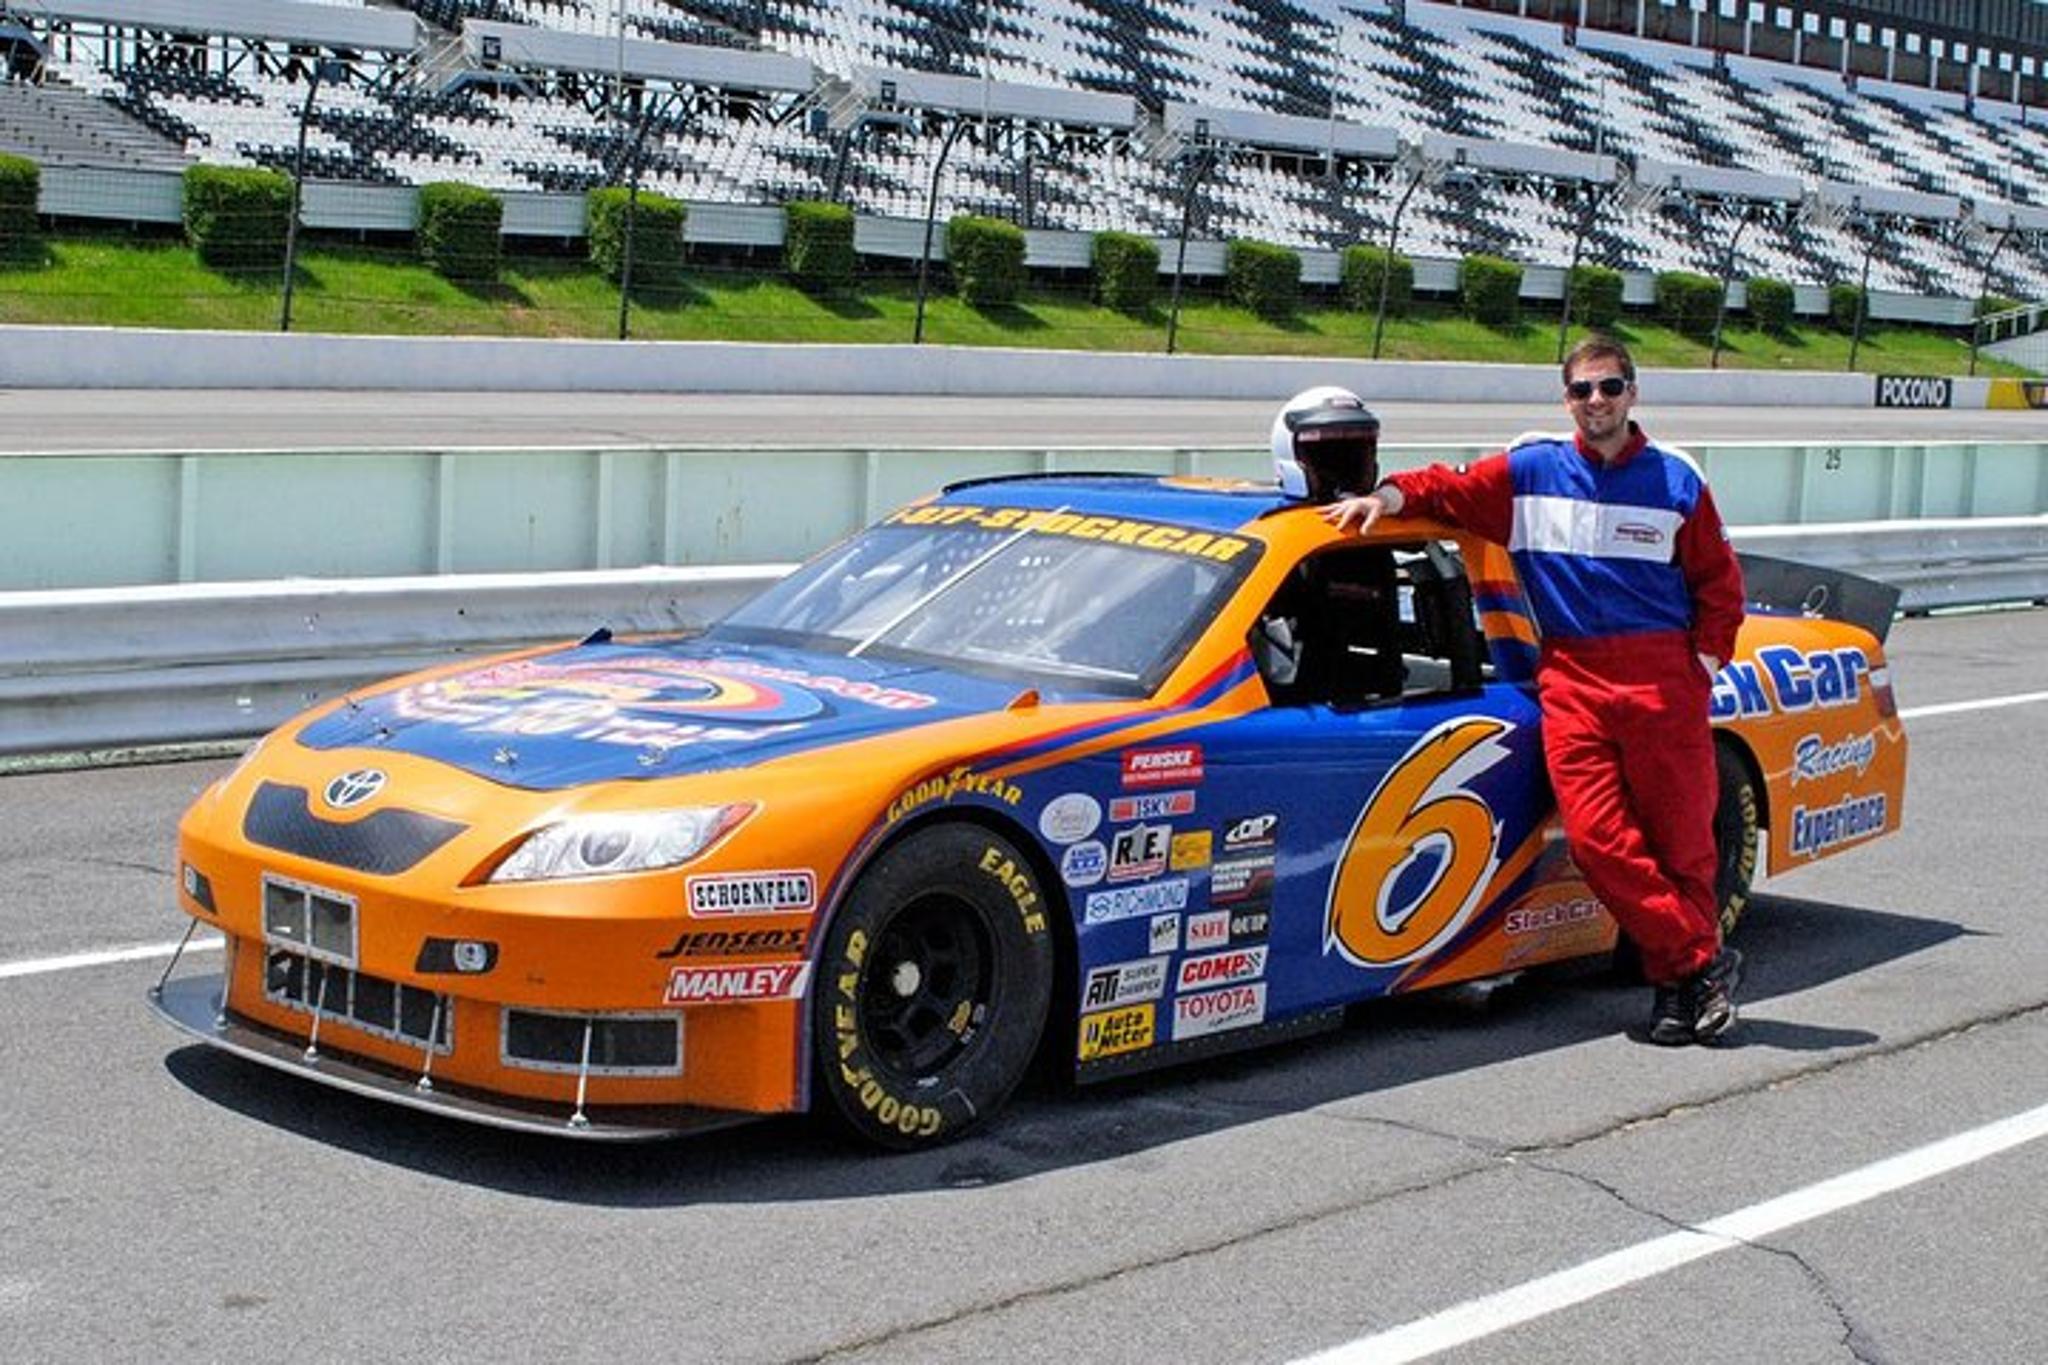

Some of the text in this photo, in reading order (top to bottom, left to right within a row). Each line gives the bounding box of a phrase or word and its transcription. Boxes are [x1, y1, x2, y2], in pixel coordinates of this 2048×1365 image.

[1881, 377, 1947, 406] POCONO
[1755, 645, 1870, 712] Car
[1792, 733, 1875, 788] Racing
[1323, 716, 1516, 968] 6
[1790, 794, 1887, 859] Experience
[696, 880, 807, 907] SCHOENFELD
[978, 846, 1046, 934] EAGLE
[673, 968, 789, 998] MANLEY
[1123, 964, 1159, 982] SUPER
[1183, 954, 1248, 984] COMP
[1086, 968, 1121, 1007] ATI
[1178, 988, 1256, 1020] TOYOTA
[836, 929, 941, 1136] GOODYEAR
[1100, 1026, 1151, 1048] Meter
[1104, 1011, 1144, 1031] Auto
